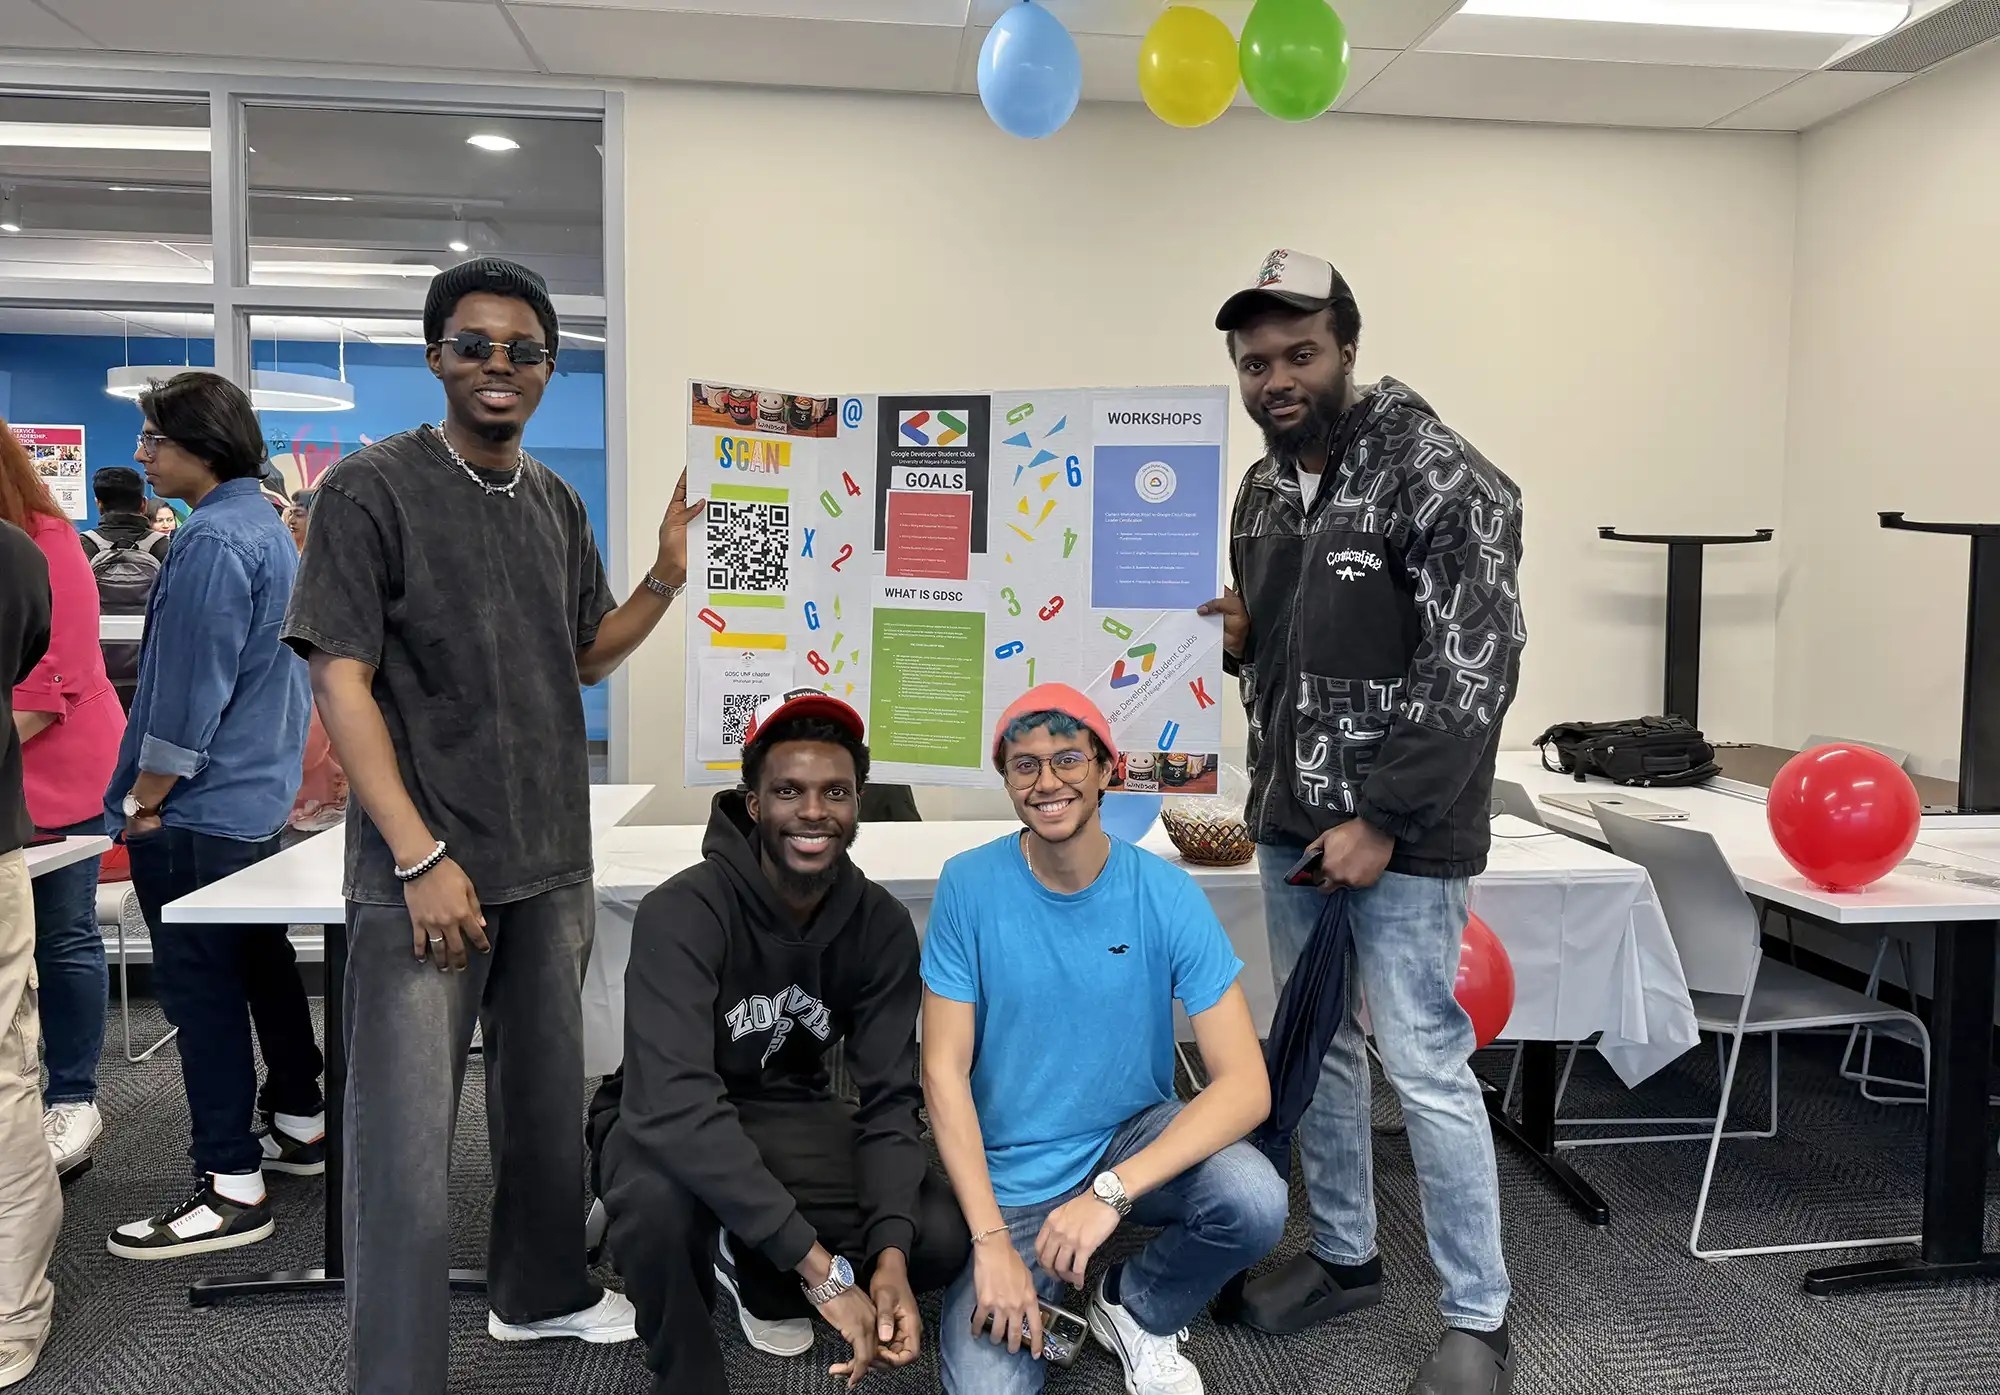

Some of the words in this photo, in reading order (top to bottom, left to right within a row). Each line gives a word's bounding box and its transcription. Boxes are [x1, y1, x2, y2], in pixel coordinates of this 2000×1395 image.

[757, 422, 786, 432] WINDSOR
[842, 398, 863, 429] @
[1108, 412, 1202, 425] WORKSHOPS
[720, 437, 780, 474] SCAN
[890, 450, 910, 458] Google
[910, 450, 937, 458] Developer
[842, 471, 861, 496] 4
[905, 472, 964, 489] GOALS
[1066, 455, 1082, 487] 6
[801, 528, 816, 558] X
[831, 543, 853, 572] 2
[885, 587, 917, 599] WHAT
[919, 589, 930, 600] IS
[932, 590, 963, 602] GDSC
[1001, 587, 1022, 617] 3
[804, 600, 820, 631] G
[1102, 616, 1133, 641] B
[751, 671, 771, 679] chapter
[806, 650, 830, 676] 8
[1026, 657, 1036, 688] 1
[1107, 708, 1121, 724] ogle
[1119, 677, 1153, 711] Developer
[1151, 653, 1179, 679] Student
[1177, 634, 1198, 654] Clubs
[1121, 700, 1144, 722] University
[1147, 679, 1166, 697] Niagara
[1164, 668, 1176, 682] Falls
[1174, 653, 1192, 671] Canada
[1189, 676, 1215, 709] K
[1157, 720, 1180, 750] U
[1126, 782, 1157, 790] WINDSOR
[184, 1207, 204, 1222] COOPER
